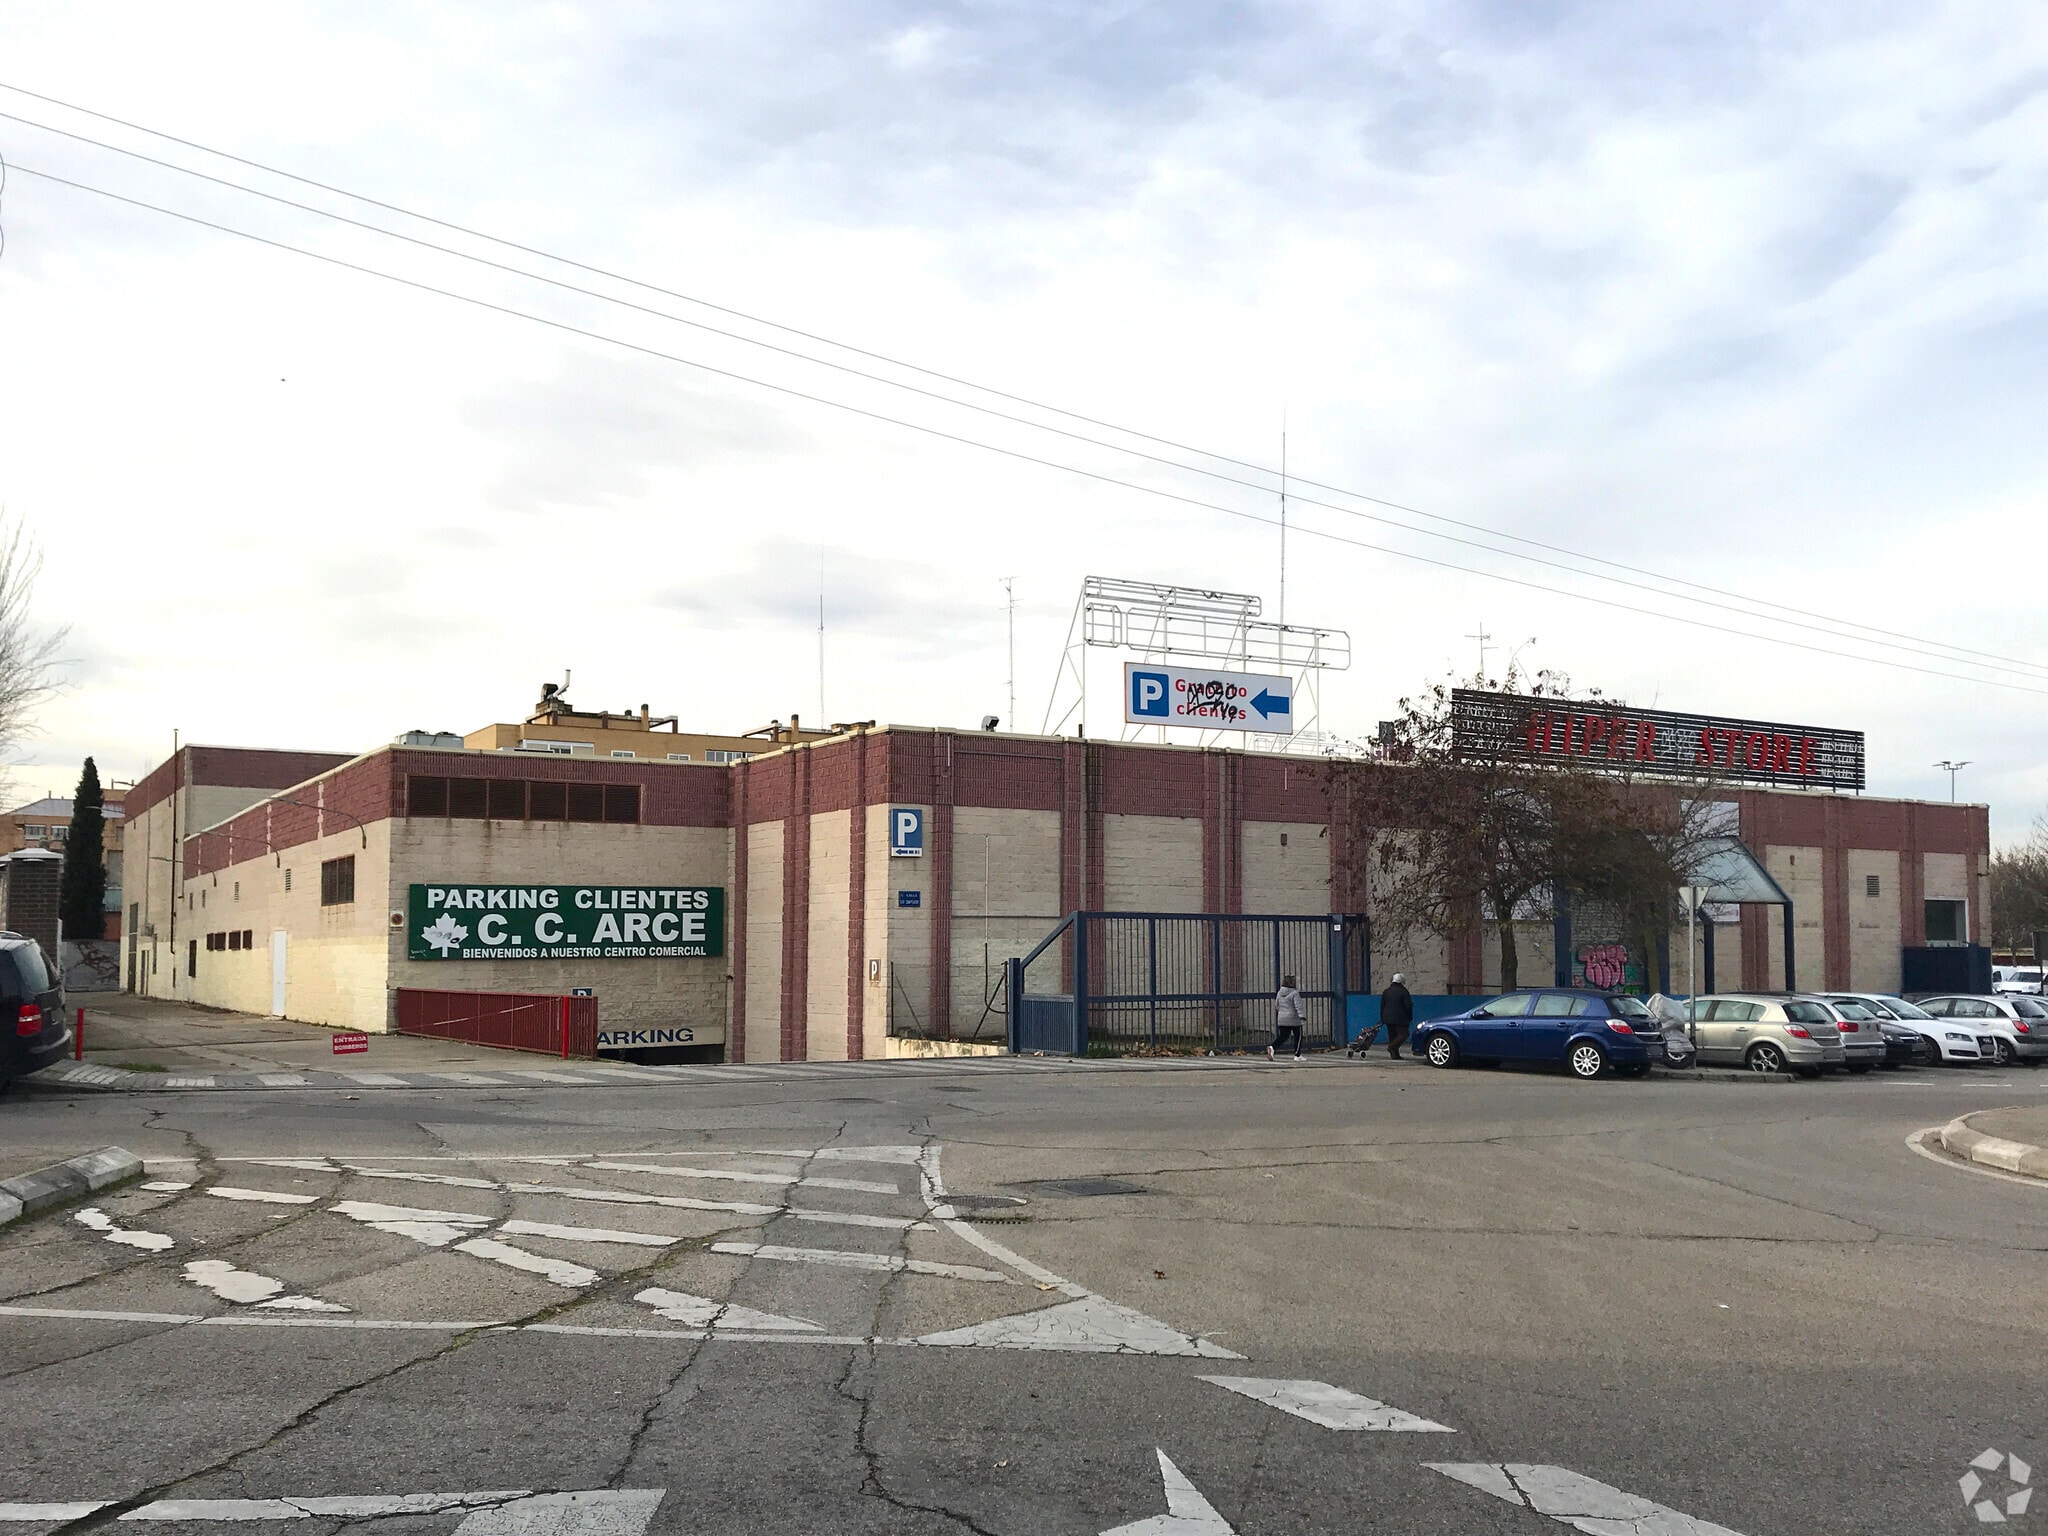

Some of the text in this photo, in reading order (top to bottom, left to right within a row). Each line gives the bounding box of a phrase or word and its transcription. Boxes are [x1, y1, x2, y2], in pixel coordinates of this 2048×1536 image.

[1140, 678, 1163, 711] P
[1527, 711, 1658, 763] HIPER
[1696, 727, 1819, 775] STORE
[898, 812, 918, 846] P
[427, 888, 710, 910] PARKING CLIENTES
[477, 912, 706, 945] C. C. ARCE
[462, 946, 707, 959] BIENVENIDOS A NUESTRO CENTRO COMERCIAL
[871, 960, 878, 981] P
[597, 1028, 694, 1046] ARKING
